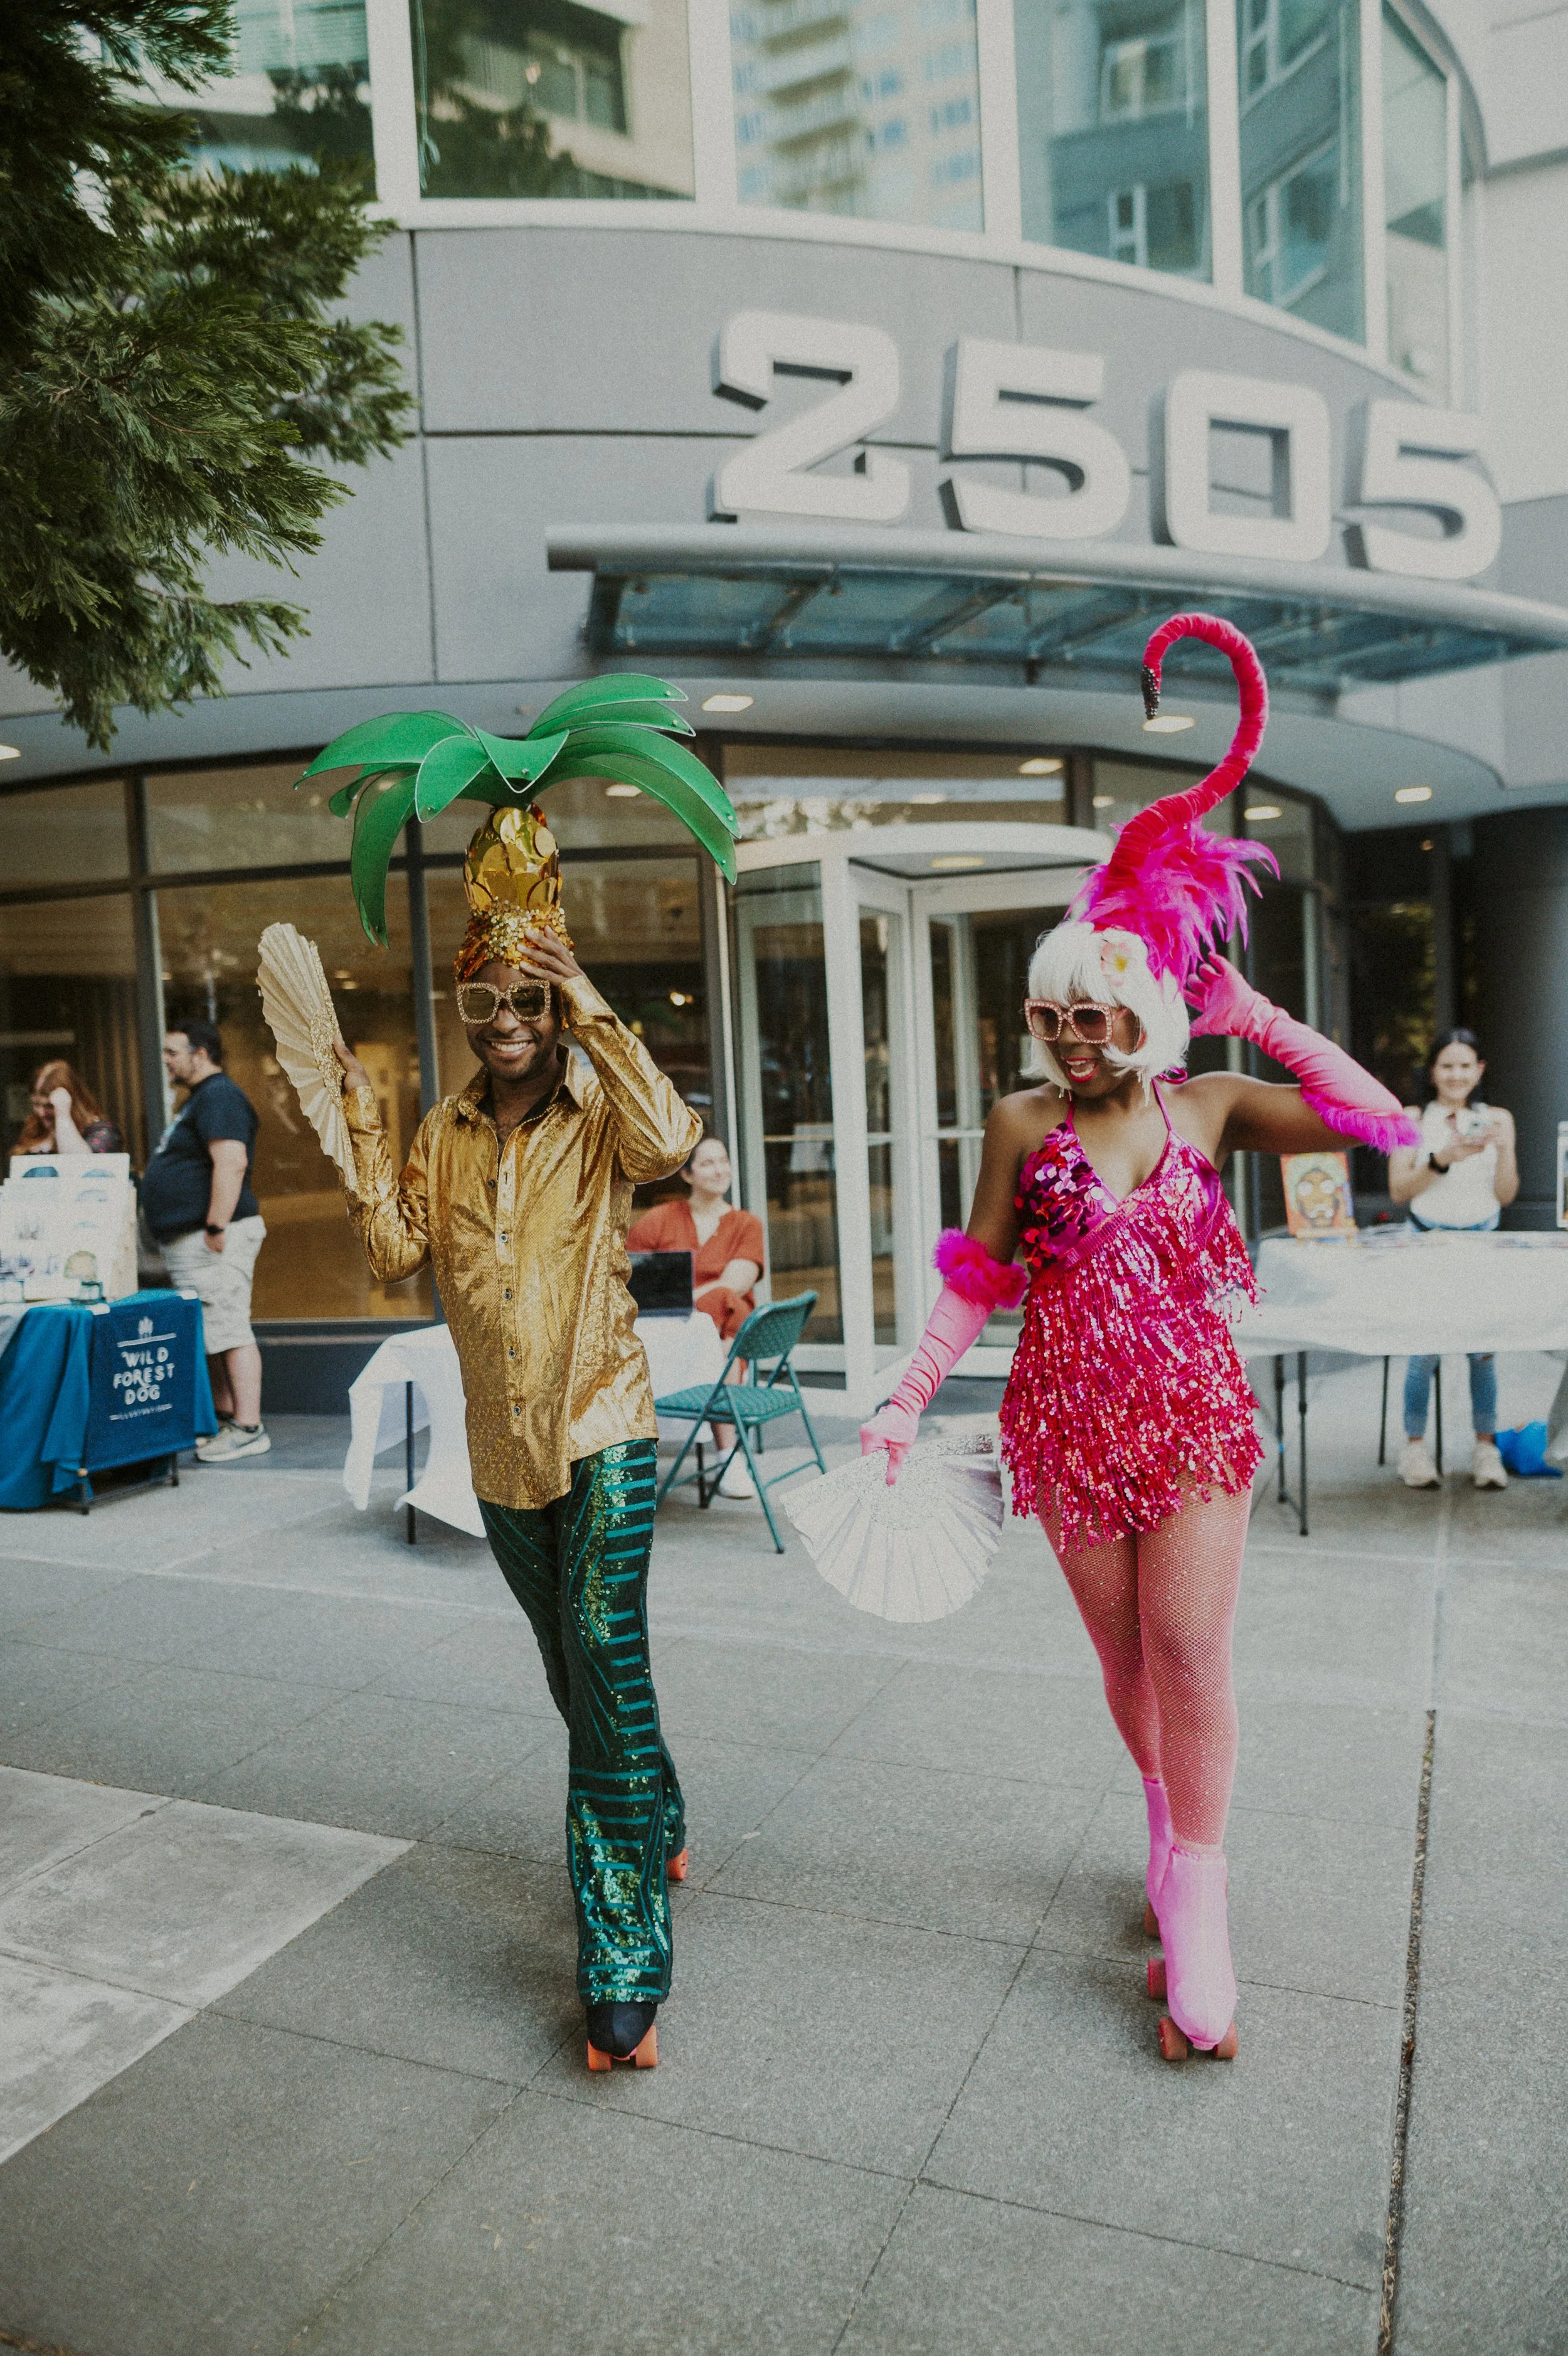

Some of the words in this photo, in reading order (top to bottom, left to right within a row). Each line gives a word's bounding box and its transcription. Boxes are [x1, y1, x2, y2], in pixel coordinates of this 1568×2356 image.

[712, 310, 1503, 580] 2505
[122, 1347, 169, 1367] WILD
[114, 1363, 175, 1389] FOREST
[125, 1384, 160, 1405] DOG
